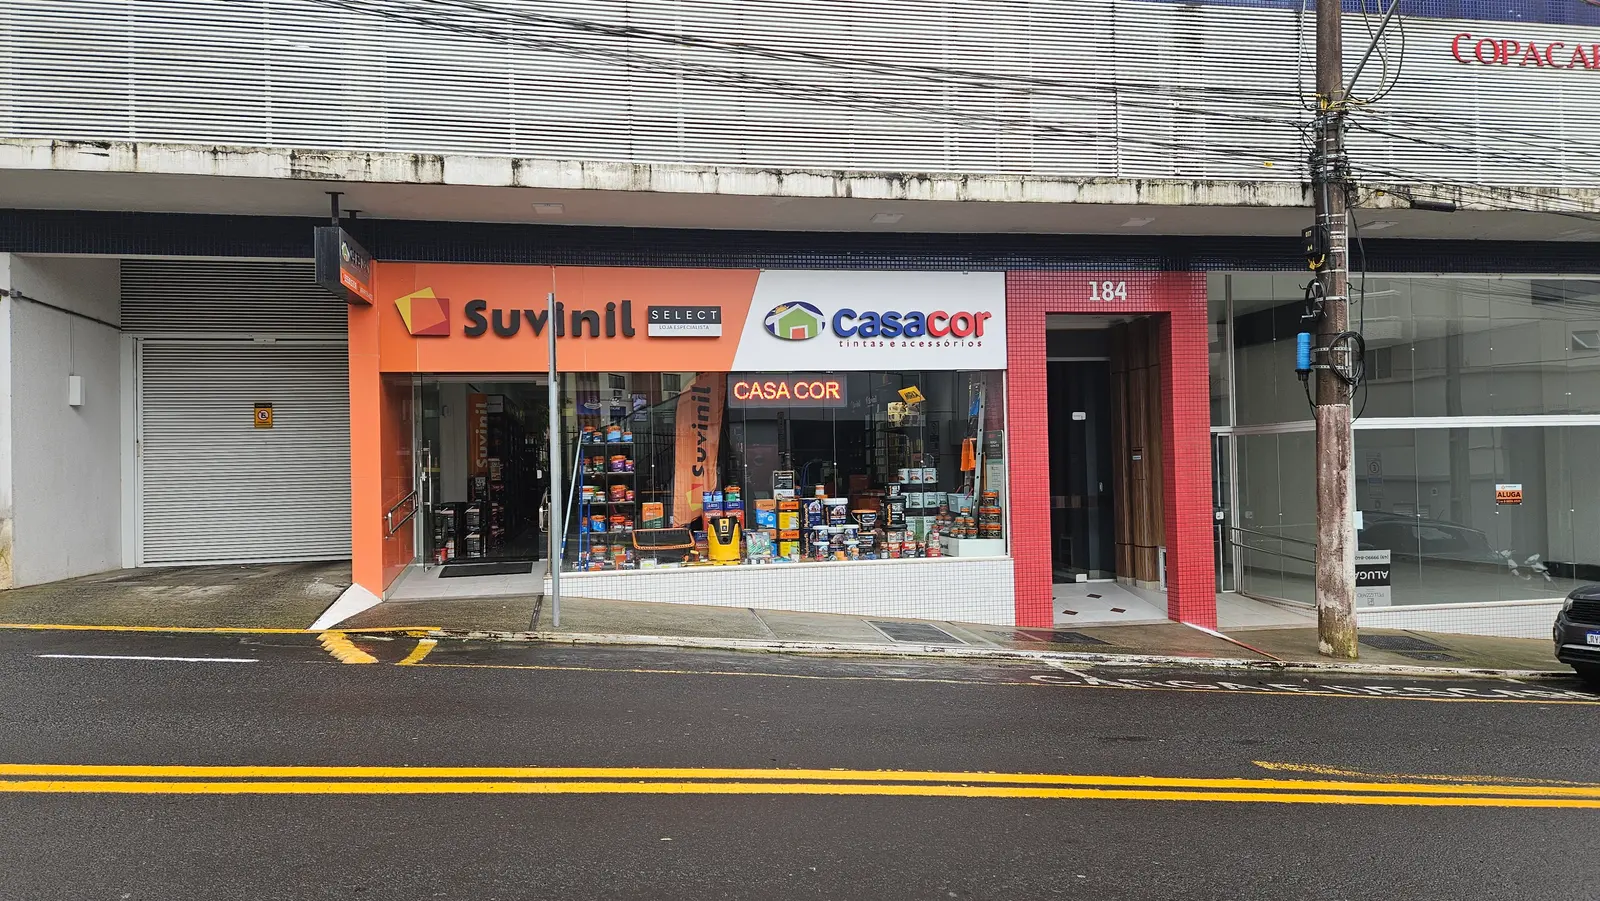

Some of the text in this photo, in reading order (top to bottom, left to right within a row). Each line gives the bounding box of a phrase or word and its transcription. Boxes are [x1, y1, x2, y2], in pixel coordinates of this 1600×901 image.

[1089, 281, 1127, 301] 184
[464, 299, 635, 337] Suvinil
[651, 310, 717, 320] SELECT
[839, 340, 884, 348] tintas
[901, 339, 982, 348] acessórios
[733, 381, 841, 400] CASA COR
[475, 403, 488, 468] Suvinil
[691, 387, 711, 477] Suvinil
